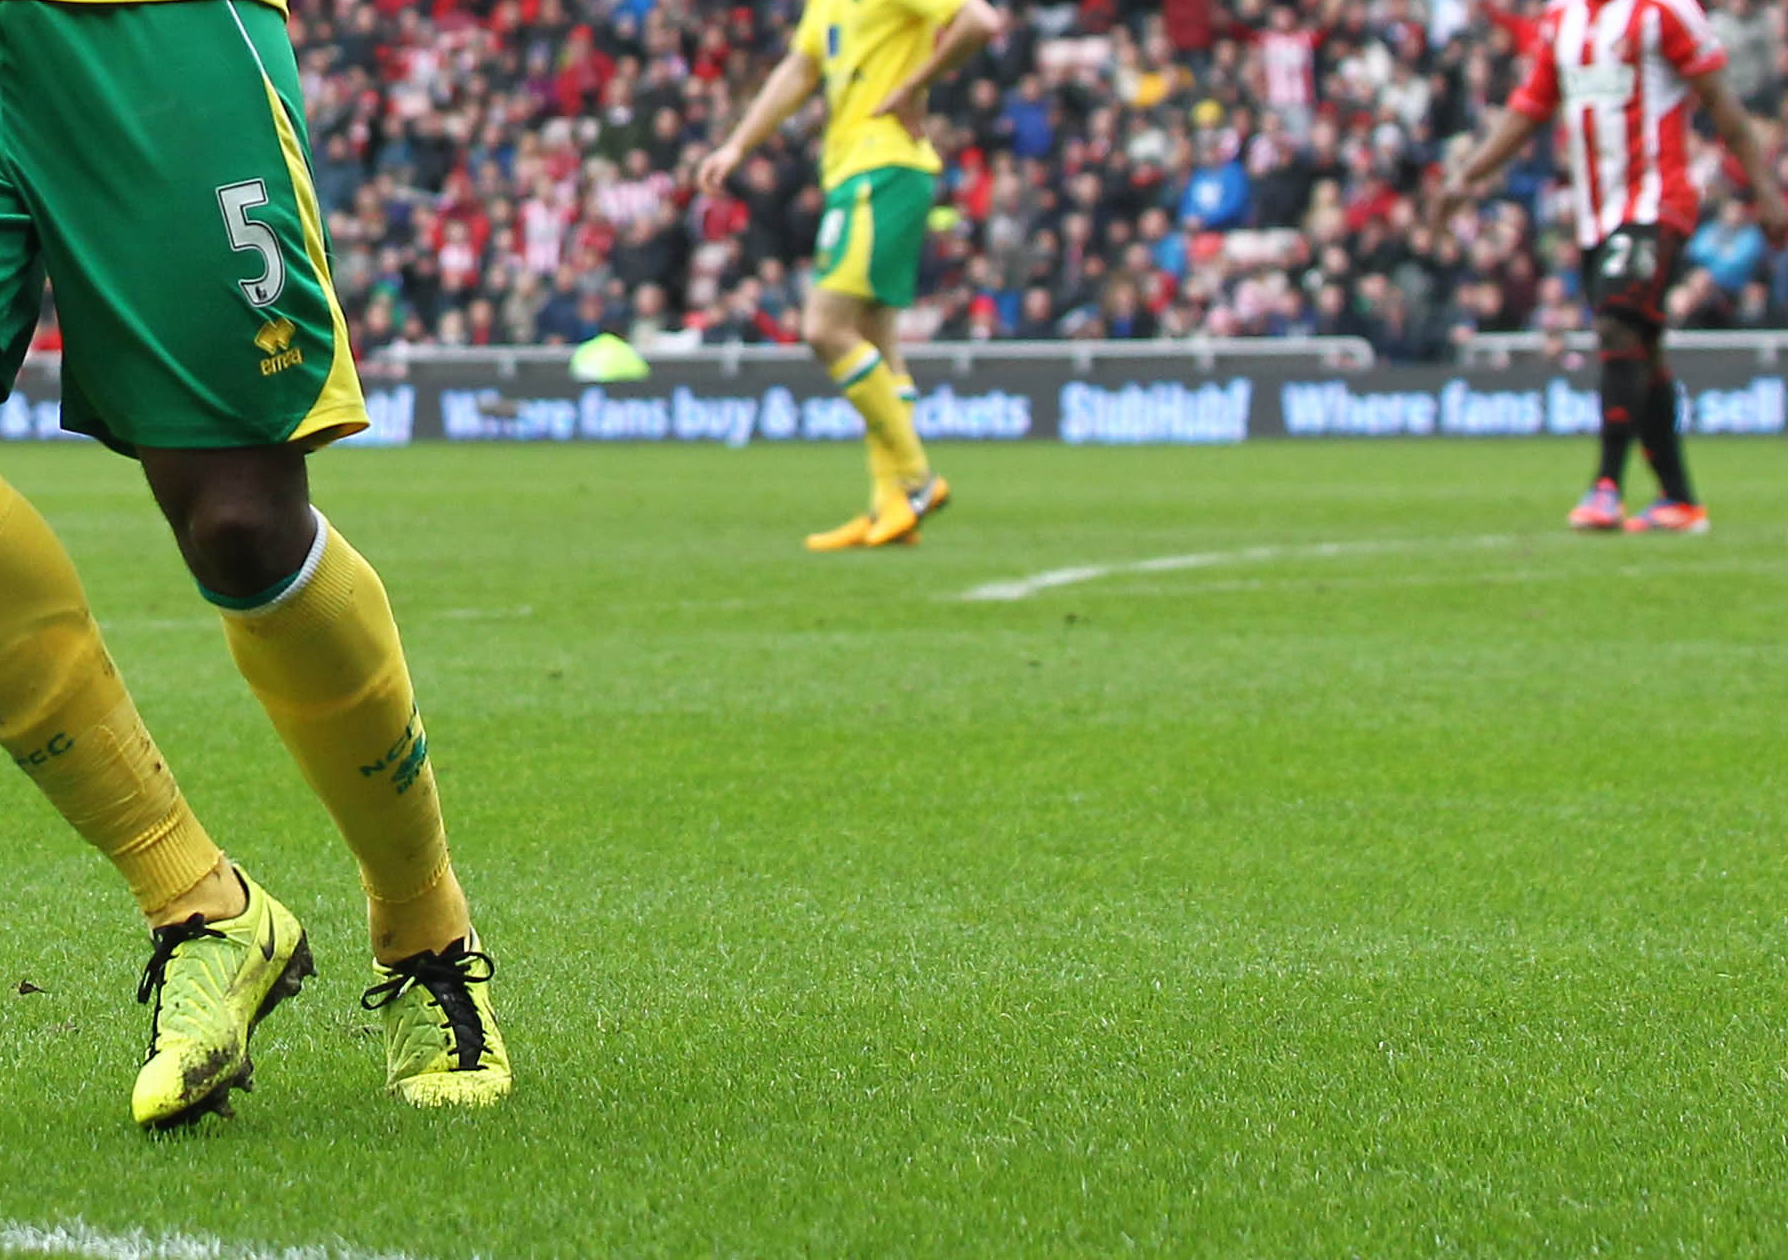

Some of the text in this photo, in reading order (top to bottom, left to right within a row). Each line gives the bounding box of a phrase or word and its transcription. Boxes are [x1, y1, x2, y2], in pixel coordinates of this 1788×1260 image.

[216, 178, 285, 307] 5
[672, 386, 758, 448] buy
[1281, 380, 1436, 435] Where
[1441, 377, 1543, 434] fans
